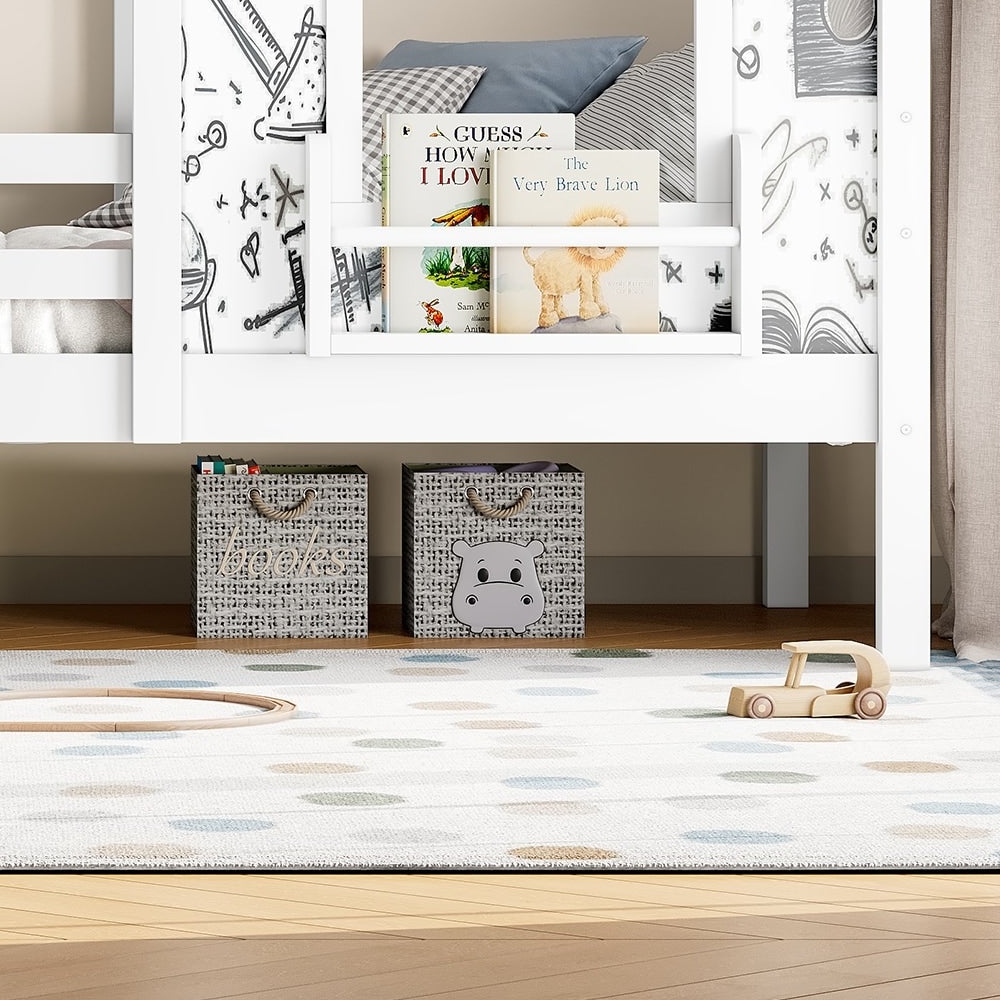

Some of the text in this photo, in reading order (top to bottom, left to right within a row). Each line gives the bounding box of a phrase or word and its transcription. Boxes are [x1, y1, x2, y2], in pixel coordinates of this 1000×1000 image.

[454, 125, 523, 142] GUESS
[425, 146, 478, 163] HOW
[563, 156, 588, 170] The
[420, 166, 428, 185] I
[513, 176, 639, 197] Very Brave Lion
[457, 301, 474, 311] Sam
[217, 526, 351, 577] books
